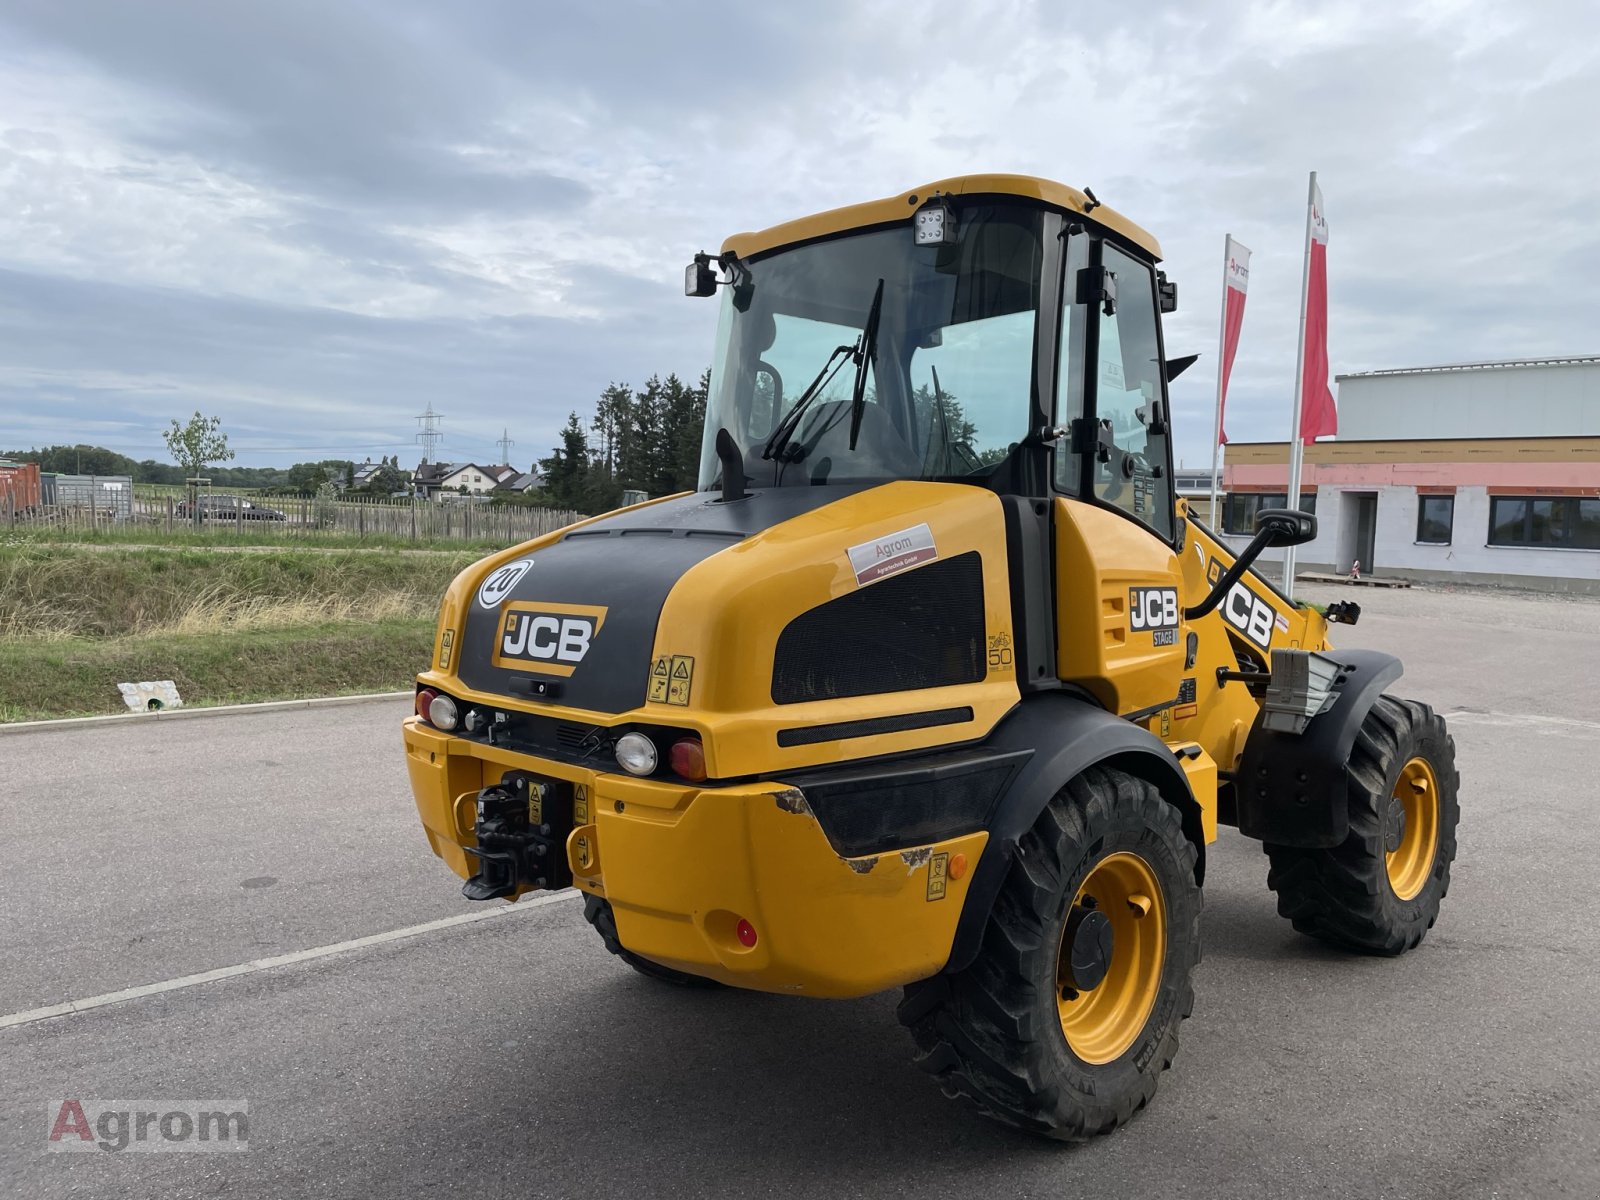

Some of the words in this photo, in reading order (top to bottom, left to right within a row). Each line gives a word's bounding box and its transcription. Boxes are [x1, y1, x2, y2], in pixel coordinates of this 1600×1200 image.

[875, 537, 913, 558] Agrom
[877, 560, 905, 575] Agrartechnik
[904, 555, 918, 566] GmbH
[484, 567, 523, 593] 20
[1131, 590, 1177, 628] JCB
[1209, 571, 1274, 647] CB
[503, 615, 592, 662] JCB
[1154, 630, 1172, 646] STAGE
[989, 648, 1012, 665] 50
